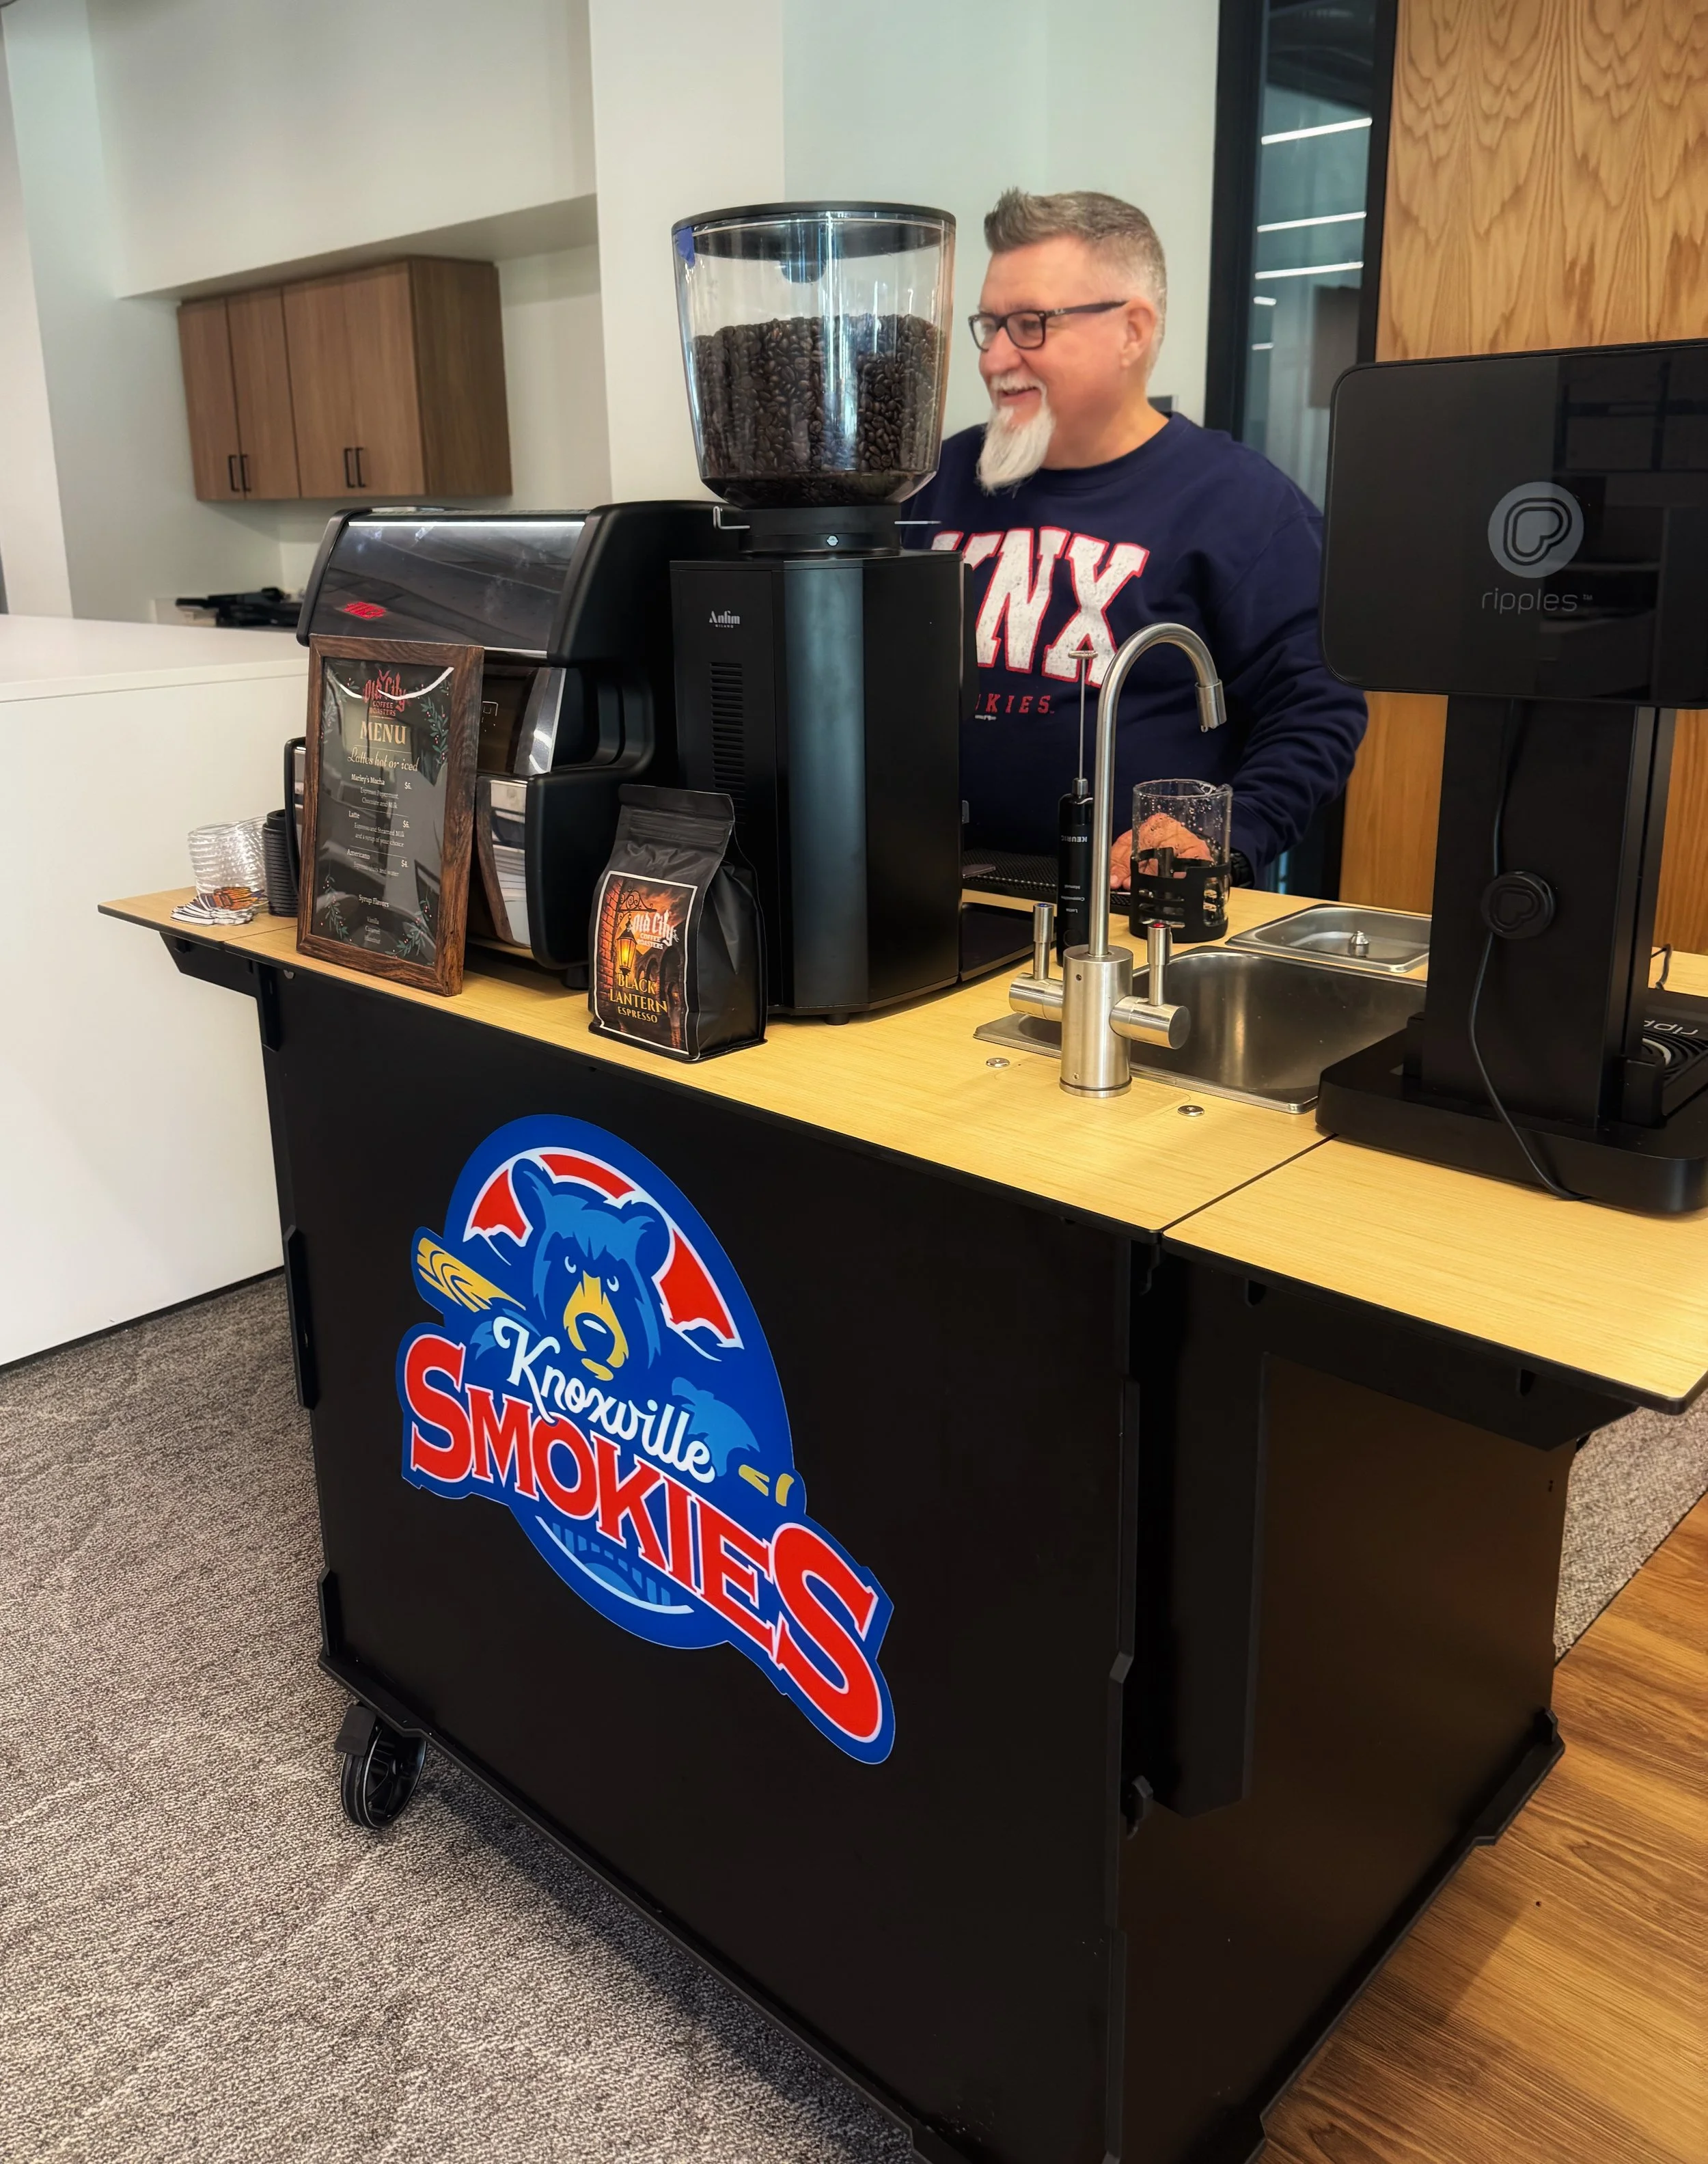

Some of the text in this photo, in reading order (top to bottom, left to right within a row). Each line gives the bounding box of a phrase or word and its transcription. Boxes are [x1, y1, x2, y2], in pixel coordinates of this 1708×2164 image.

[1482, 588, 1578, 614] ripples
[708, 610, 741, 625] Anfim
[369, 707, 396, 717] ROASTERS
[372, 701, 394, 709] COFFEE
[975, 693, 1051, 714] KIES
[360, 720, 407, 745] MENU
[347, 747, 420, 771] Lattes hot or iced
[370, 776, 385, 786] Mocha
[348, 810, 360, 819] Latte
[347, 849, 370, 860] Americano
[359, 893, 390, 908] Syrup Flavors
[632, 909, 675, 947] Old City
[639, 932, 662, 942] COFFEE
[618, 974, 656, 994] BLACK
[610, 989, 667, 1013] LANTERN
[618, 1006, 657, 1023] ESPRESSO
[493, 1316, 716, 1482] Knoxville
[405, 1333, 883, 1744] SMOKIES
